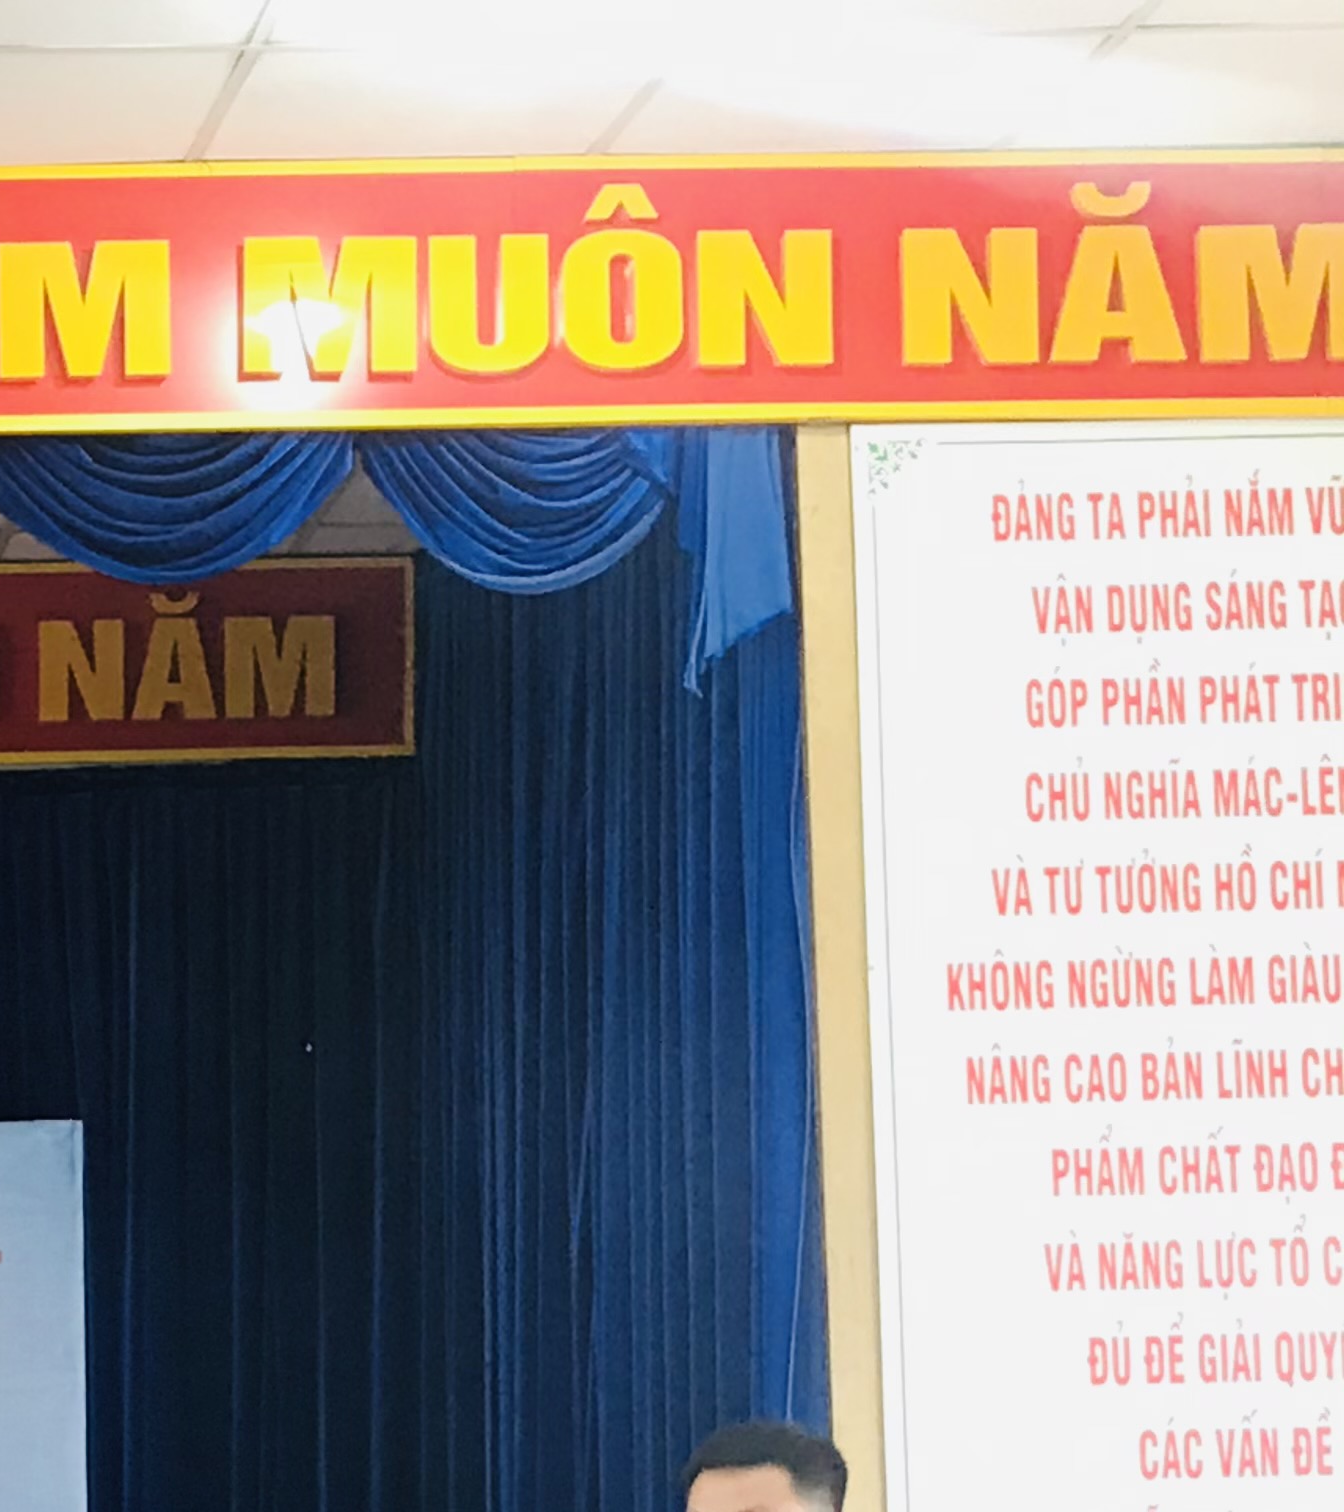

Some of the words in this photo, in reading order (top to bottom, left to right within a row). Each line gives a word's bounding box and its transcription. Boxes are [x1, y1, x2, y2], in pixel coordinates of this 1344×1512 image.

[241, 183, 834, 382] MUÔN
[902, 180, 1344, 365] NĂM
[991, 480, 1076, 542] ĐẢNG
[1086, 492, 1126, 540] TA
[1137, 475, 1212, 539] PHẢI
[1223, 469, 1295, 537] NẮM
[1031, 573, 1094, 646] VẬN
[1106, 581, 1193, 644] DỤNG
[1205, 569, 1288, 631] SÁNG
[1298, 579, 1344, 640] TẠ
[38, 590, 336, 722] NĂM
[1026, 666, 1088, 729] GÓP
[1101, 658, 1186, 726] PHẦN
[1199, 663, 1280, 724] PHÁT
[1025, 757, 1090, 823] CHỦ
[1104, 759, 1202, 820] NGHĨA
[1213, 753, 1344, 817] MÁC-LÊ
[991, 855, 1033, 916] VÀ
[1043, 859, 1084, 916] TƯ
[1094, 849, 1202, 915] TƯỞNG
[1214, 844, 1257, 912] HỒ
[1269, 849, 1324, 912] CHÍ
[946, 949, 1055, 1012] KHÔNG
[1067, 946, 1177, 1009] NGỪNG
[1189, 944, 1255, 1006] LÀM
[1267, 942, 1342, 1005] GIÀU
[966, 1043, 1051, 1105] NÂNG
[1064, 1052, 1127, 1104] CAO
[1140, 1037, 1204, 1101] BẢN
[1216, 1039, 1289, 1099] LĨNH
[1051, 1125, 1145, 1197] PHẨM
[1158, 1127, 1241, 1196] CHẤT
[1253, 1142, 1318, 1203] ĐẠO
[1044, 1231, 1086, 1292] VÀ
[1098, 1233, 1184, 1291] NĂNG
[1197, 1232, 1257, 1300] LỰC
[1269, 1214, 1309, 1287] TỔ
[1087, 1321, 1131, 1386] ĐỦ
[1143, 1312, 1185, 1384] ĐỂ
[1198, 1319, 1262, 1384] GIẢI
[1275, 1331, 1344, 1387] QUY
[1139, 1418, 1203, 1481] CÁC
[1215, 1409, 1279, 1478] VẤN
[1291, 1408, 1333, 1476] ĐỀ
